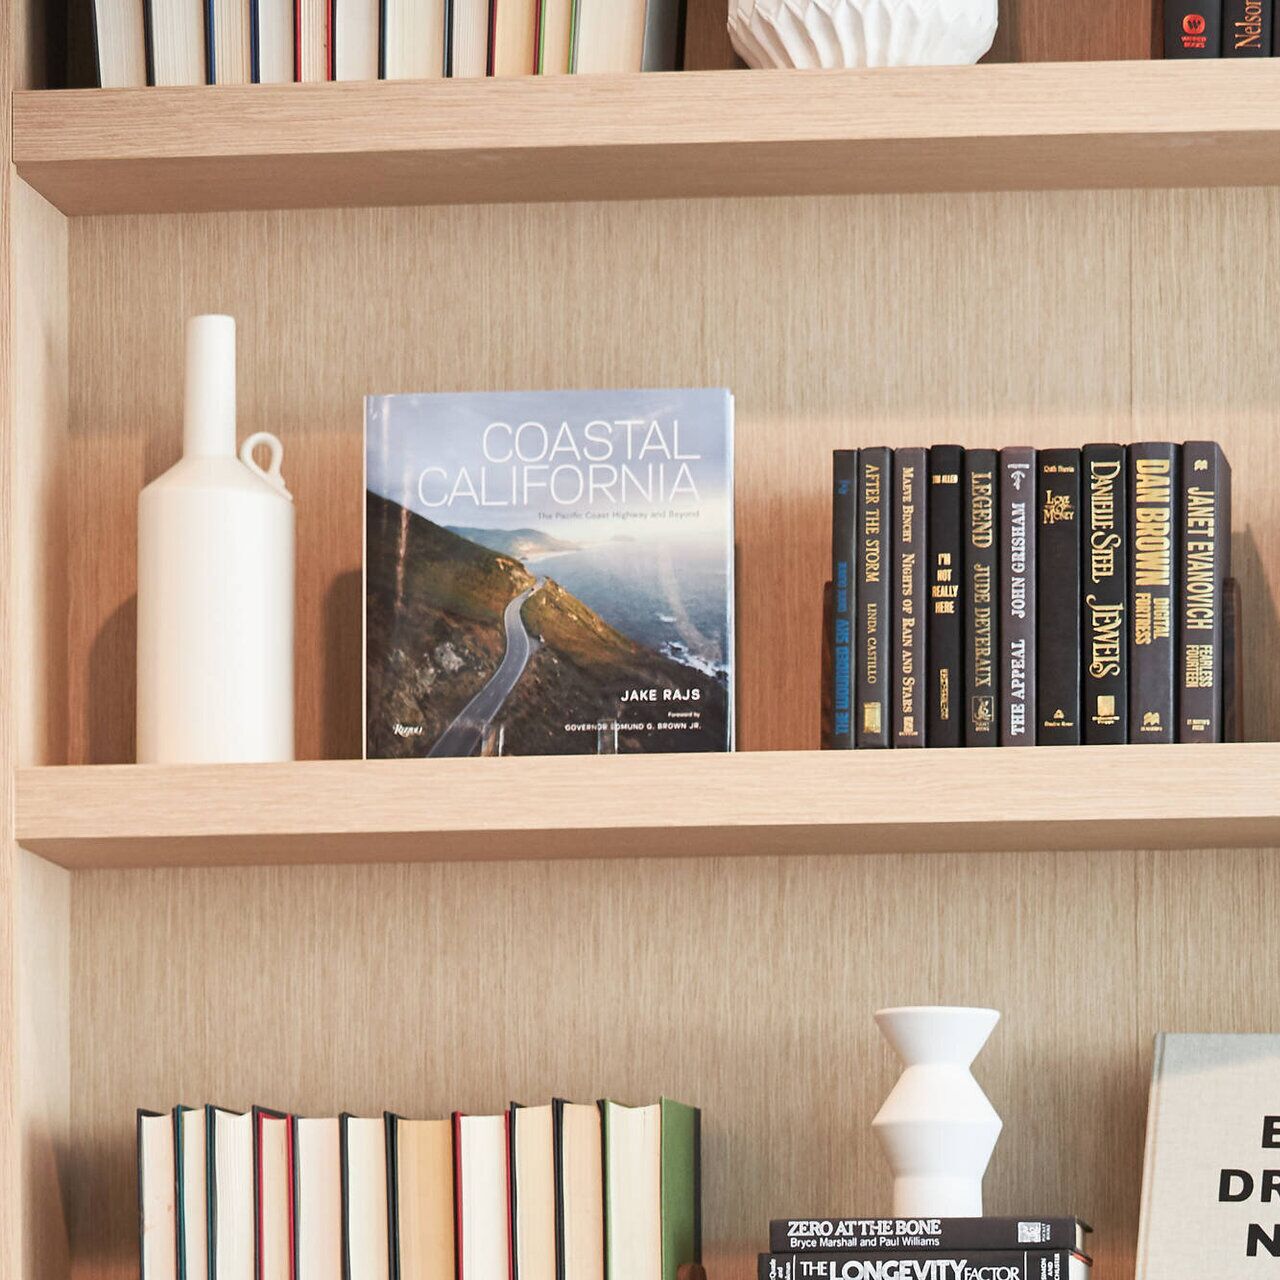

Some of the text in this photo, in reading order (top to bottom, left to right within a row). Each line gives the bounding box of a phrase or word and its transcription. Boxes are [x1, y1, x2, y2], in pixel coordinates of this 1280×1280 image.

[483, 420, 701, 463] COASTAL
[418, 463, 700, 506] CALIFORNIA
[555, 511, 583, 520] Pacific
[585, 511, 610, 519] Coast
[612, 511, 648, 520] Highway
[669, 511, 699, 520] Beyond
[866, 465, 880, 582] AFTER THE STORM
[972, 472, 992, 548] LEGEND
[1136, 460, 1169, 585] DAN BROWN
[1012, 503, 1025, 619] JOHN GRISHAM
[1185, 487, 1214, 629] JANET EVANOVICH
[1135, 593, 1151, 644] FORTRESS
[1153, 598, 1169, 639] DIGITAL
[867, 604, 876, 683] LINDA CASTILLO
[621, 688, 701, 702] JAKE RAJS
[1012, 639, 1026, 735] THE APPEAL
[787, 1219, 942, 1236] ZERO AT THE BONE
[790, 1236, 939, 1248] Bryce Marshall and Paul Williams
[801, 1261, 827, 1276] THE
[964, 1267, 1020, 1280] FACTOR
